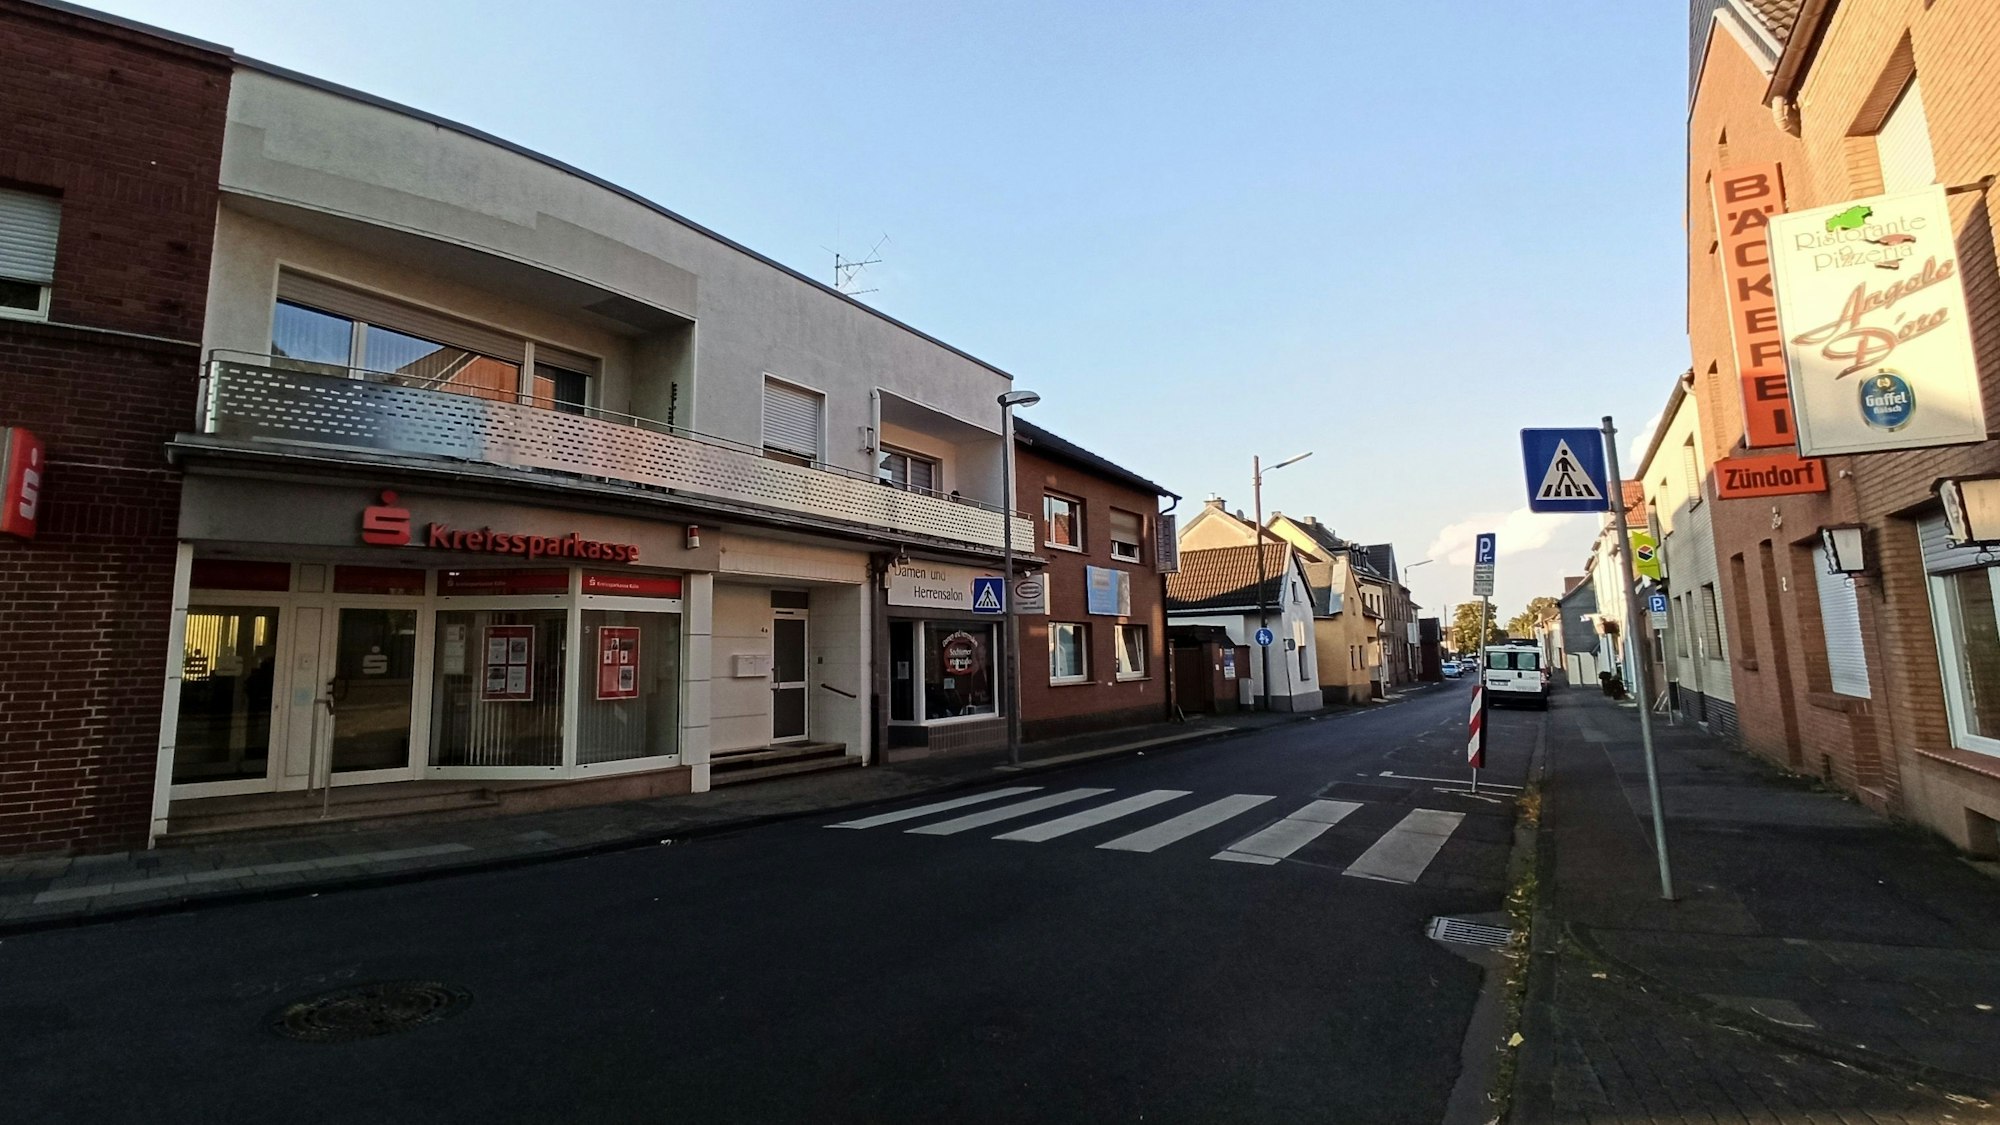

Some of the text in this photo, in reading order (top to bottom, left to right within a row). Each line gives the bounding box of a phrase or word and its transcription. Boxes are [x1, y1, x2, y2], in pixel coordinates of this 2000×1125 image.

[1794, 215, 1926, 251] Ristorante
[1814, 244, 1913, 271] Pizzeria
[1723, 173, 1788, 434] BÄCKEREI
[1791, 255, 1956, 345] Angolo
[1865, 391, 1908, 407] Gaffel
[1724, 462, 1815, 491] Zündorf
[426, 521, 641, 562] Kreissparkasse
[894, 564, 947, 582] Damen und
[914, 585, 964, 602] Herrensalon
